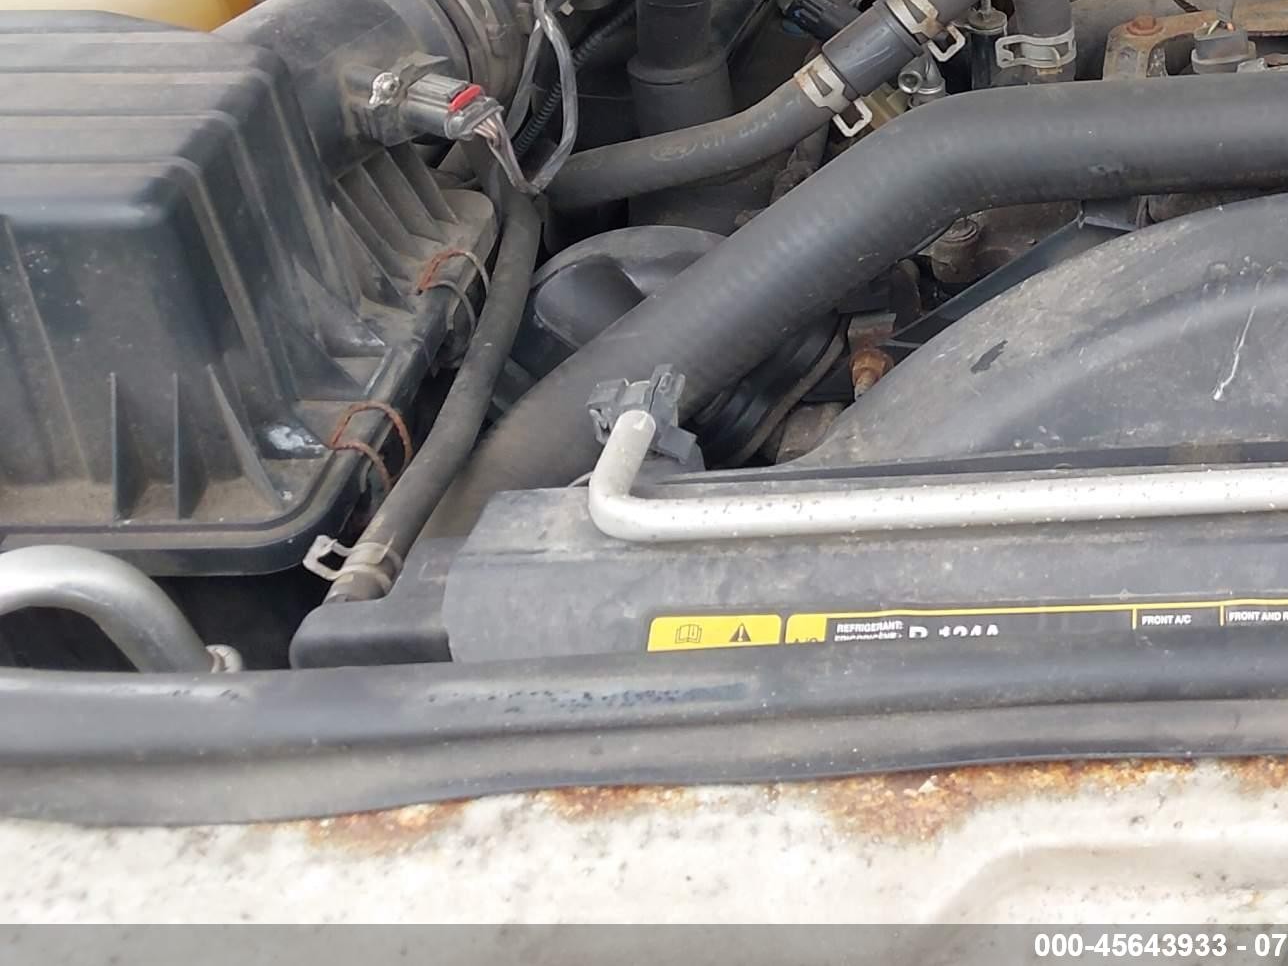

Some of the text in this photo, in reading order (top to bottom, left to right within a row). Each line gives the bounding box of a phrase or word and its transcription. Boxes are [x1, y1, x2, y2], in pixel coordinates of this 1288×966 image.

[1141, 614, 1192, 625] FRONT A/C
[1228, 611, 1260, 621] FRONT
[1261, 611, 1281, 621] AND
